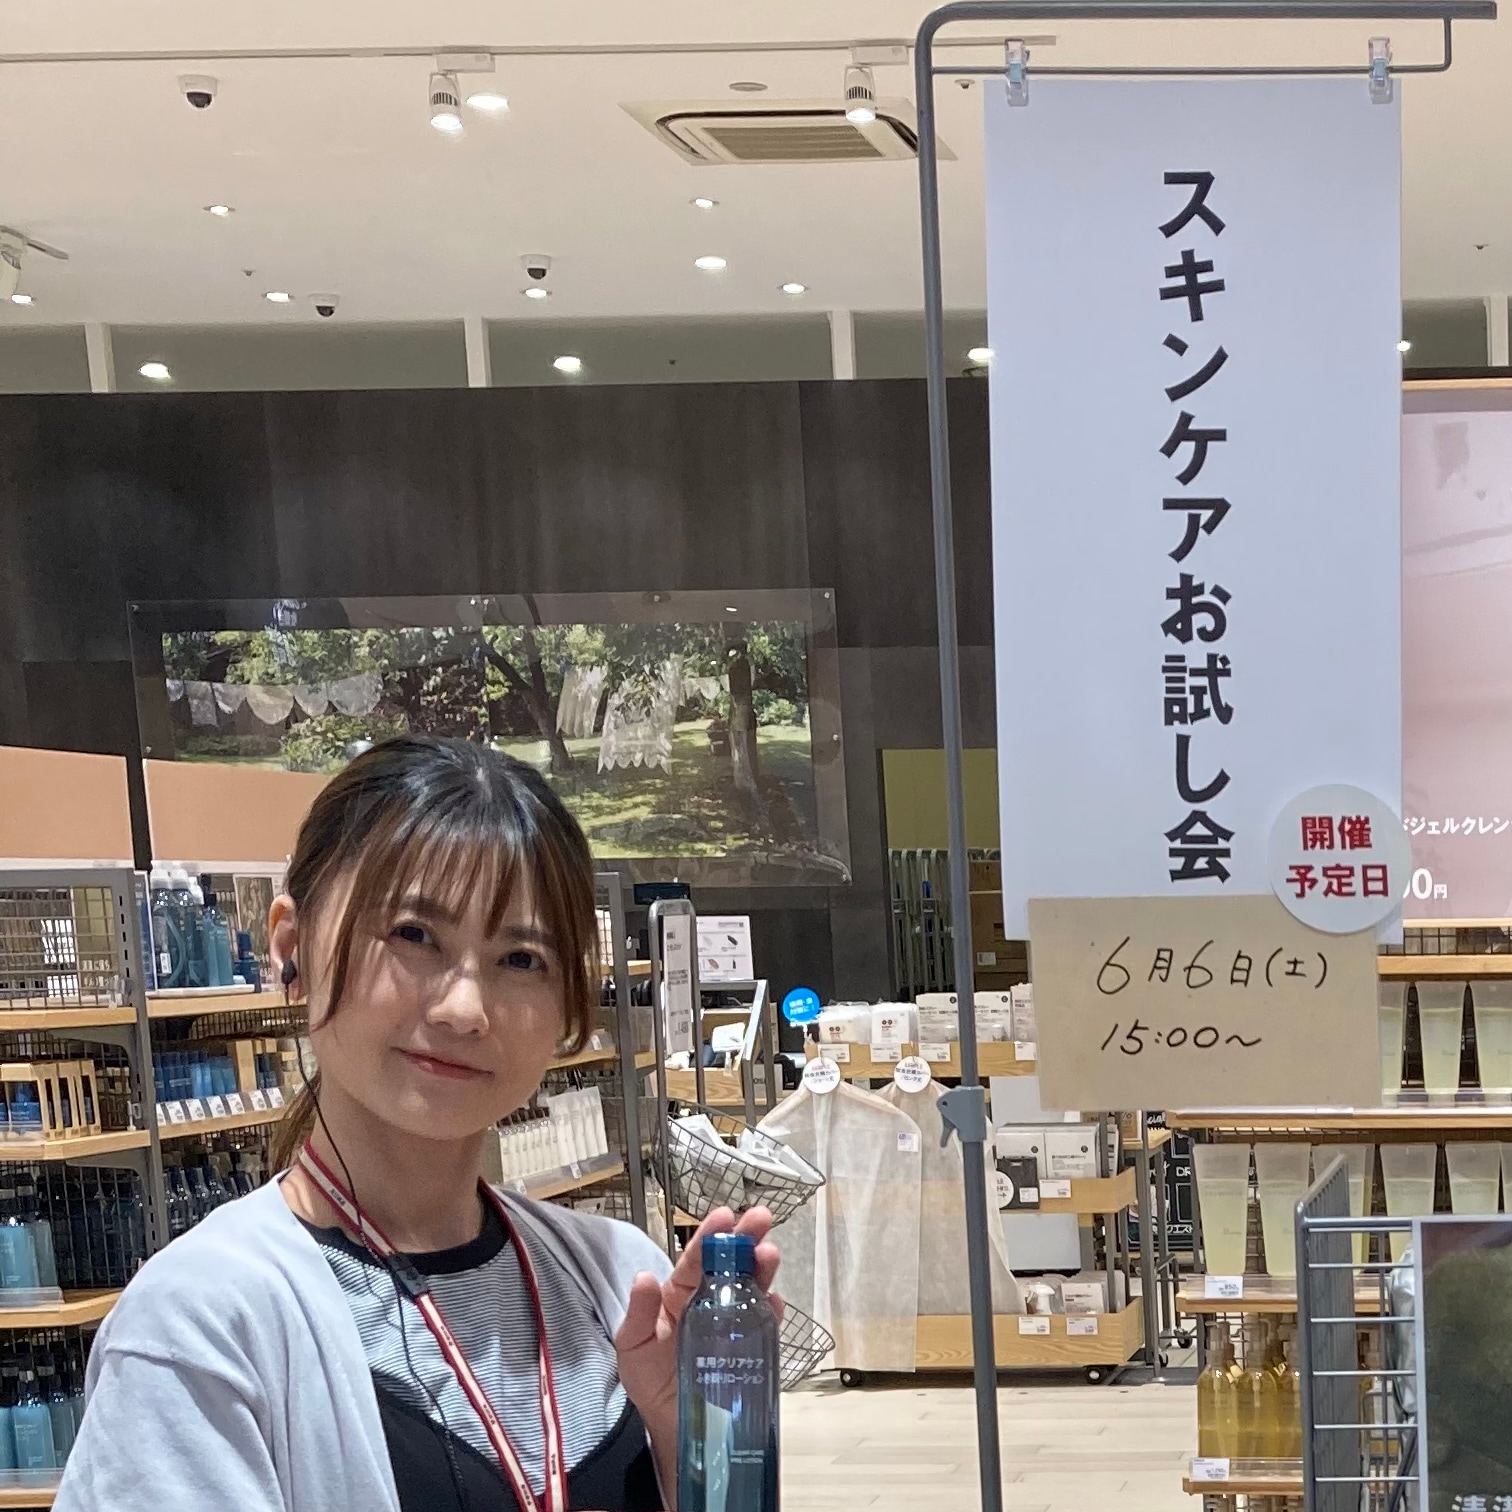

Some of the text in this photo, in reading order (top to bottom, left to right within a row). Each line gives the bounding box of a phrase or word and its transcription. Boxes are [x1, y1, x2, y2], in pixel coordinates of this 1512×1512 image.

[1157, 169, 1236, 884] スキンケアお試し会
[1300, 815, 1374, 851] 開催
[1286, 863, 1391, 900] 予定日
[1097, 936, 1328, 995] 6月6日(土)
[696, 1356, 765, 1369] 薬用クリアケア
